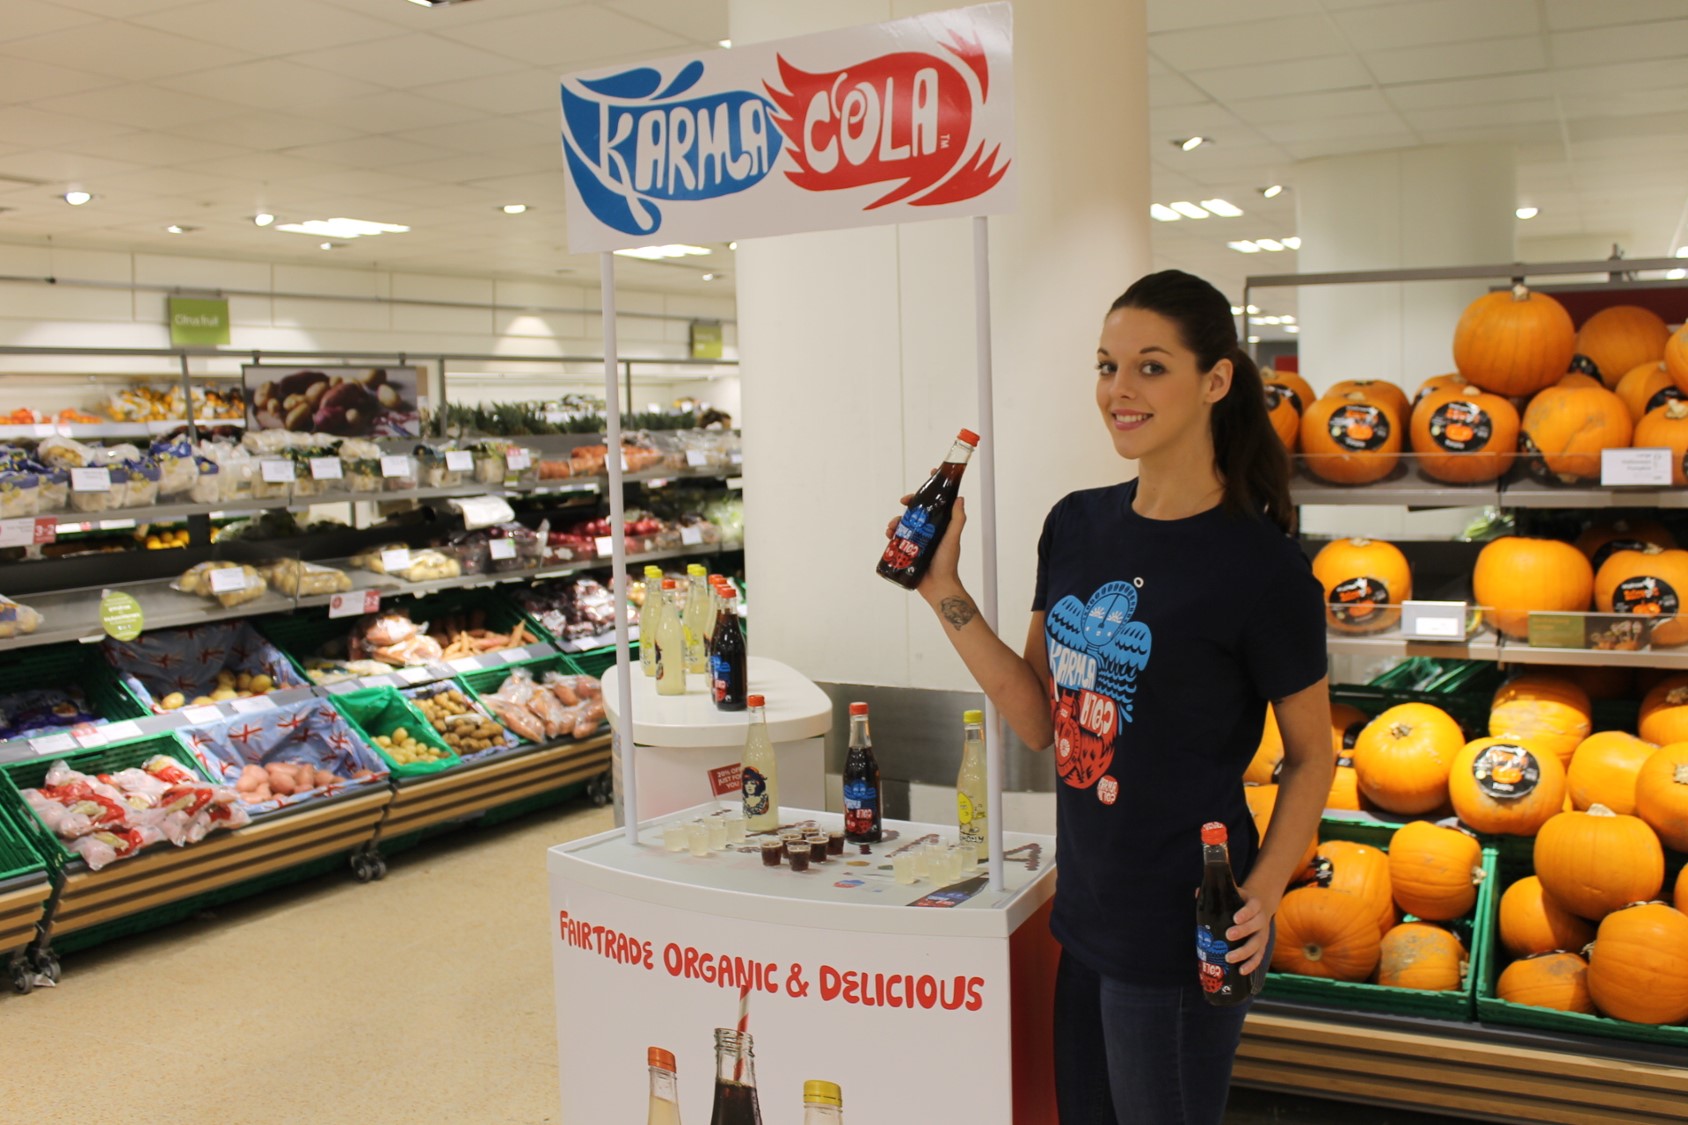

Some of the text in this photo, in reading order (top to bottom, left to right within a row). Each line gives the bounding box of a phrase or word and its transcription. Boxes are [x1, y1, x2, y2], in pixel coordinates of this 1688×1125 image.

[592, 67, 940, 206] KARMA COLA
[940, 133, 950, 149] TM
[174, 313, 219, 328] Citrus fruit
[1050, 639, 1098, 701] KARMA
[1080, 692, 1115, 737] COLA
[717, 776, 731, 786] JUST
[560, 910, 985, 1012] FAIRTRADE ORGANIC & DELICIOUS
